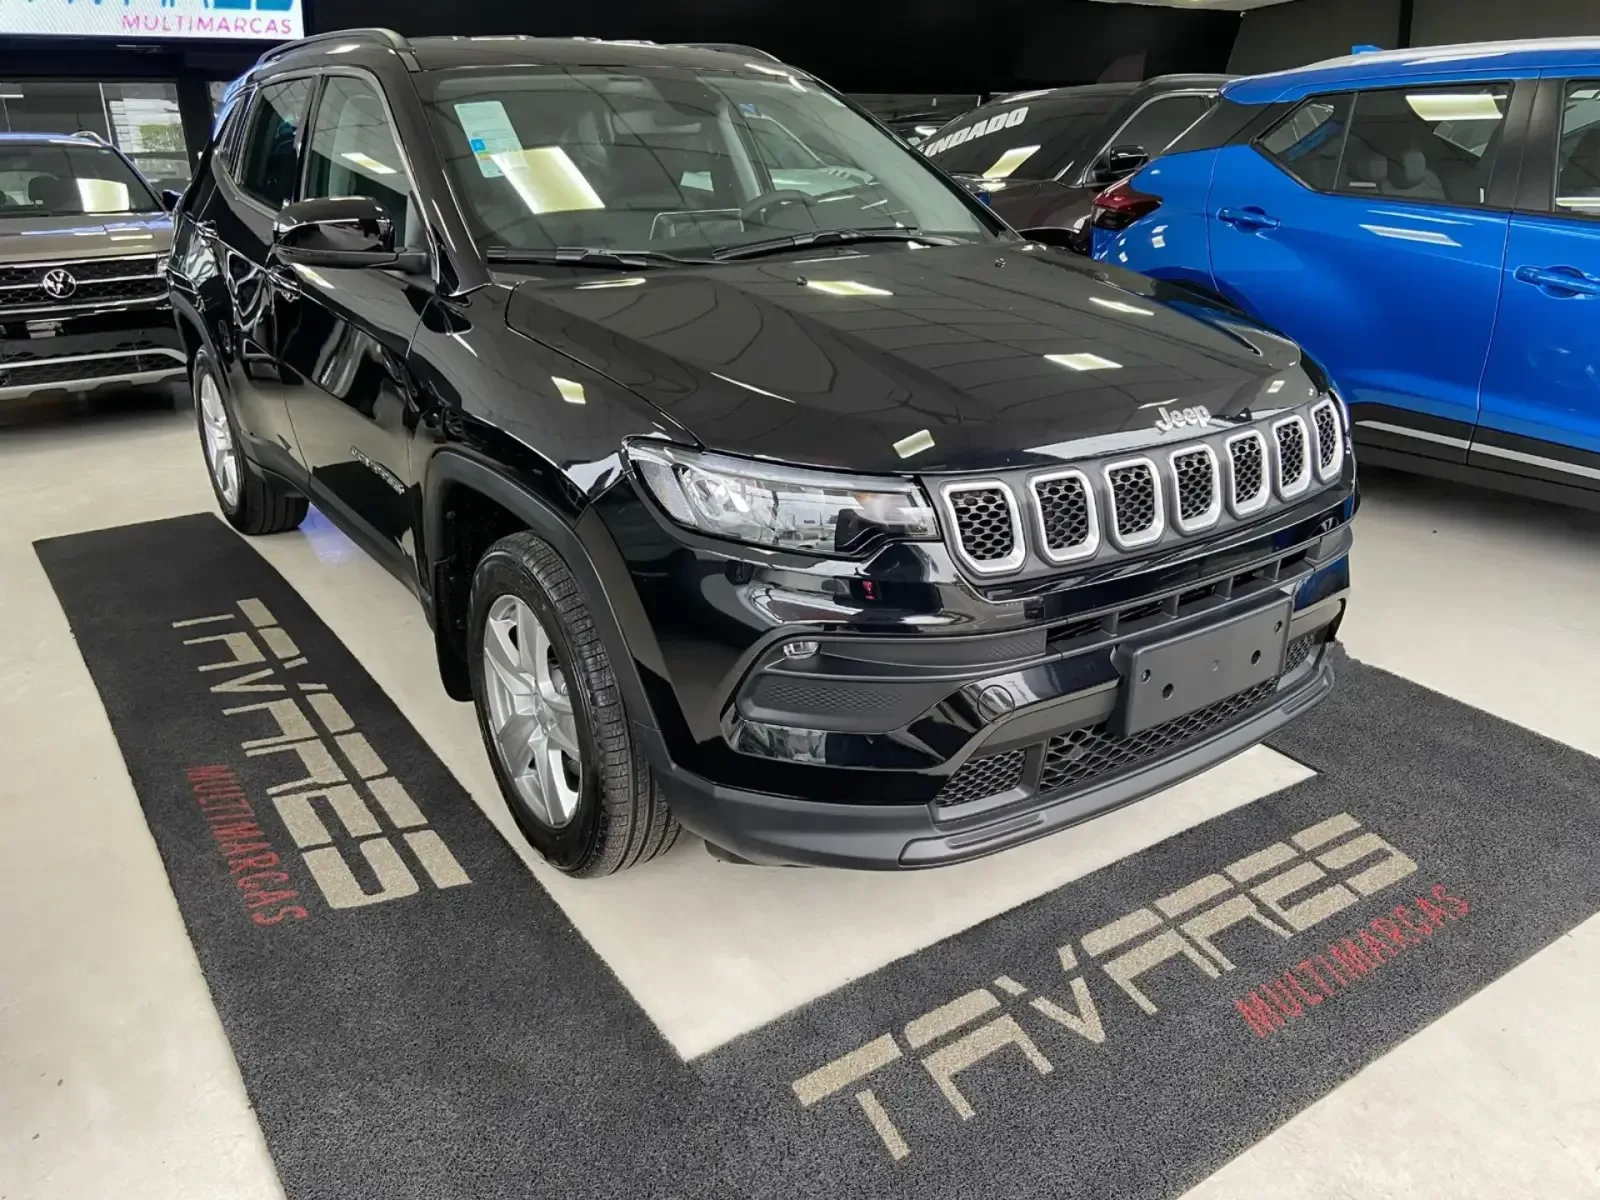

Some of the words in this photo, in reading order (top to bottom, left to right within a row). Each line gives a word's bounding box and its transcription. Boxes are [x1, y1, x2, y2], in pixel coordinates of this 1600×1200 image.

[122, 15, 292, 34] MULTIMARCAS
[1155, 405, 1211, 430] Jeep
[172, 598, 472, 909] TAVARES
[184, 764, 309, 927] MULTIMARCAS
[793, 812, 1418, 1161] TAVARES
[1234, 883, 1469, 1039] MULTIMARCAS
